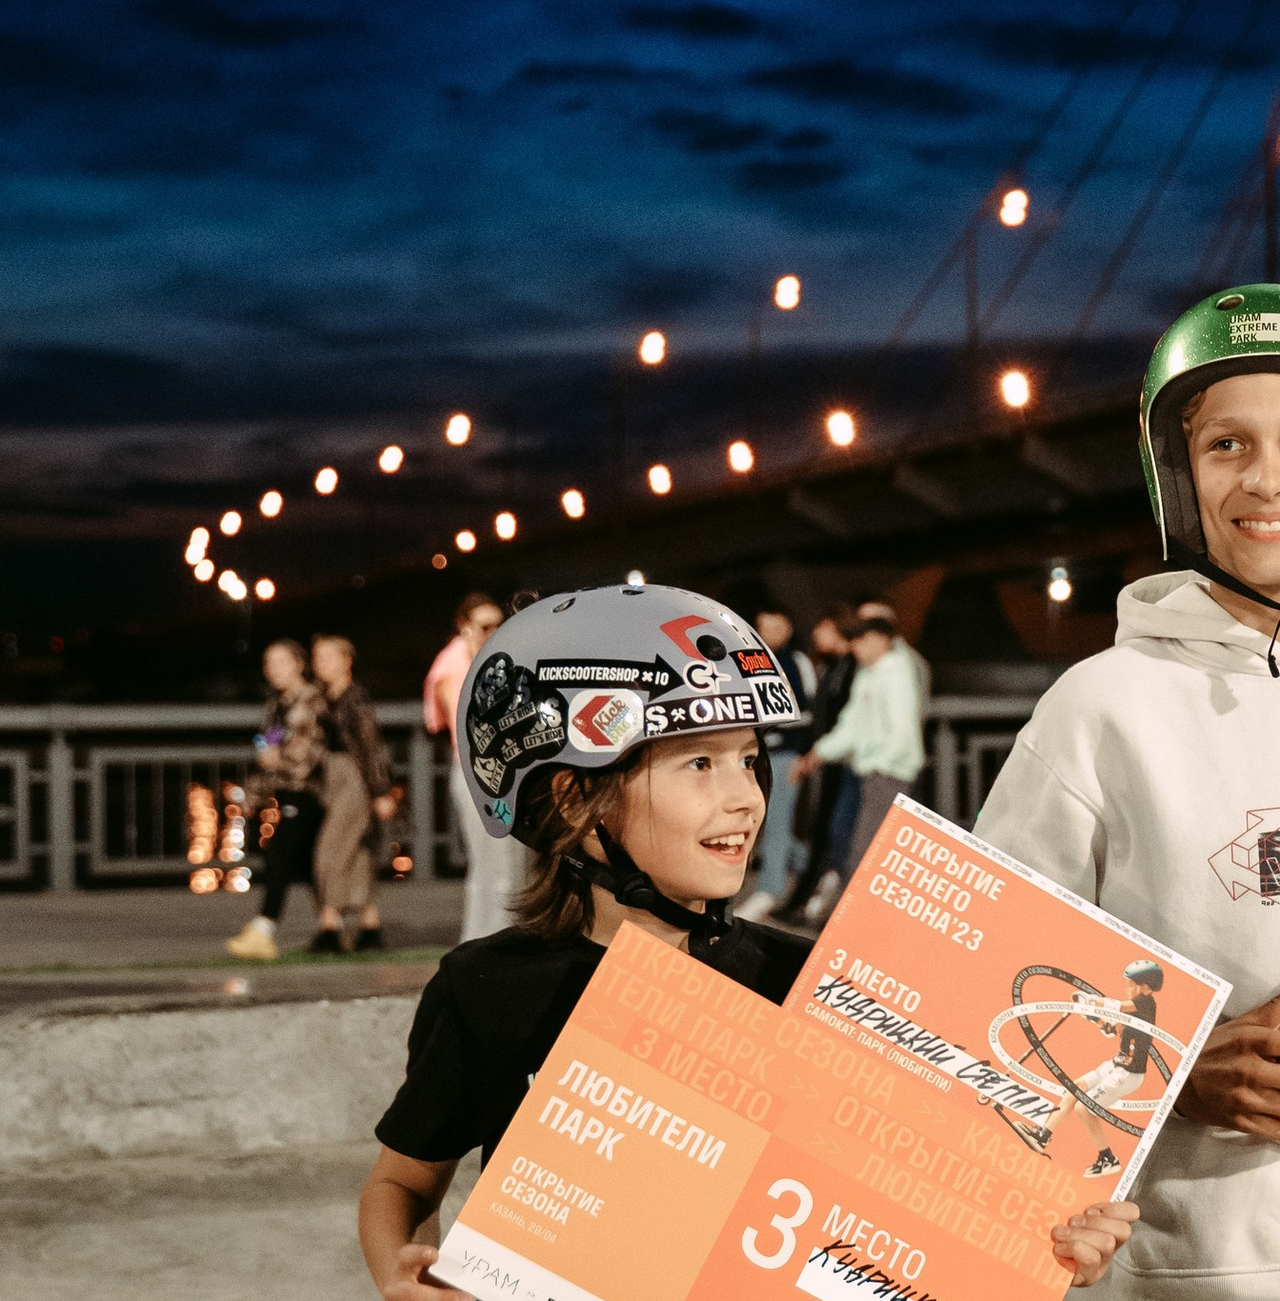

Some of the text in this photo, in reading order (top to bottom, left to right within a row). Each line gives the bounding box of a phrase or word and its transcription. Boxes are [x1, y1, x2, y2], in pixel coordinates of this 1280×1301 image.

[1230, 313, 1261, 324] URAM
[1230, 323, 1278, 334] EXTREME
[1230, 333, 1257, 343] PARK
[538, 665, 640, 684] KICKSCOOTERSHOP
[754, 681, 793, 716] KSS
[500, 704, 534, 728] LET'S RIDE
[525, 729, 564, 748] LET'S RIDE
[594, 699, 626, 730] Kick
[879, 847, 974, 914] ЛЕТНЕГО
[892, 823, 1007, 902] ОТКРЫТИЕ
[866, 871, 987, 953] СЕЗОНА'23
[826, 946, 923, 1014] 3 МЕСТО
[803, 1000, 953, 1094] САМОКАТ: ПАРК (ЛЮБИТЕЛИ)
[536, 1093, 627, 1162] ПАРК
[556, 1057, 728, 1170] ЛЮБИТЕЛИ
[685, 1012, 779, 1083] ПАРК
[830, 1093, 1002, 1207] ОТКРЫТИЕ
[995, 1185, 1065, 1244] СЕЗ
[769, 1013, 903, 1106] СЕЗОНА
[956, 1120, 1085, 1210] КАЗАНЬ
[509, 1154, 606, 1218] ОТКРЫТИЕ
[629, 1024, 1080, 1296] 3 МЕСТО ЛЮБИТЕЛИ ПА
[498, 1173, 573, 1226] СЕЗОНА
[741, 1178, 930, 1283] 3 МЕСТО
[526, 1220, 558, 1245] 29/04
[457, 1249, 522, 1296] УРАМ
